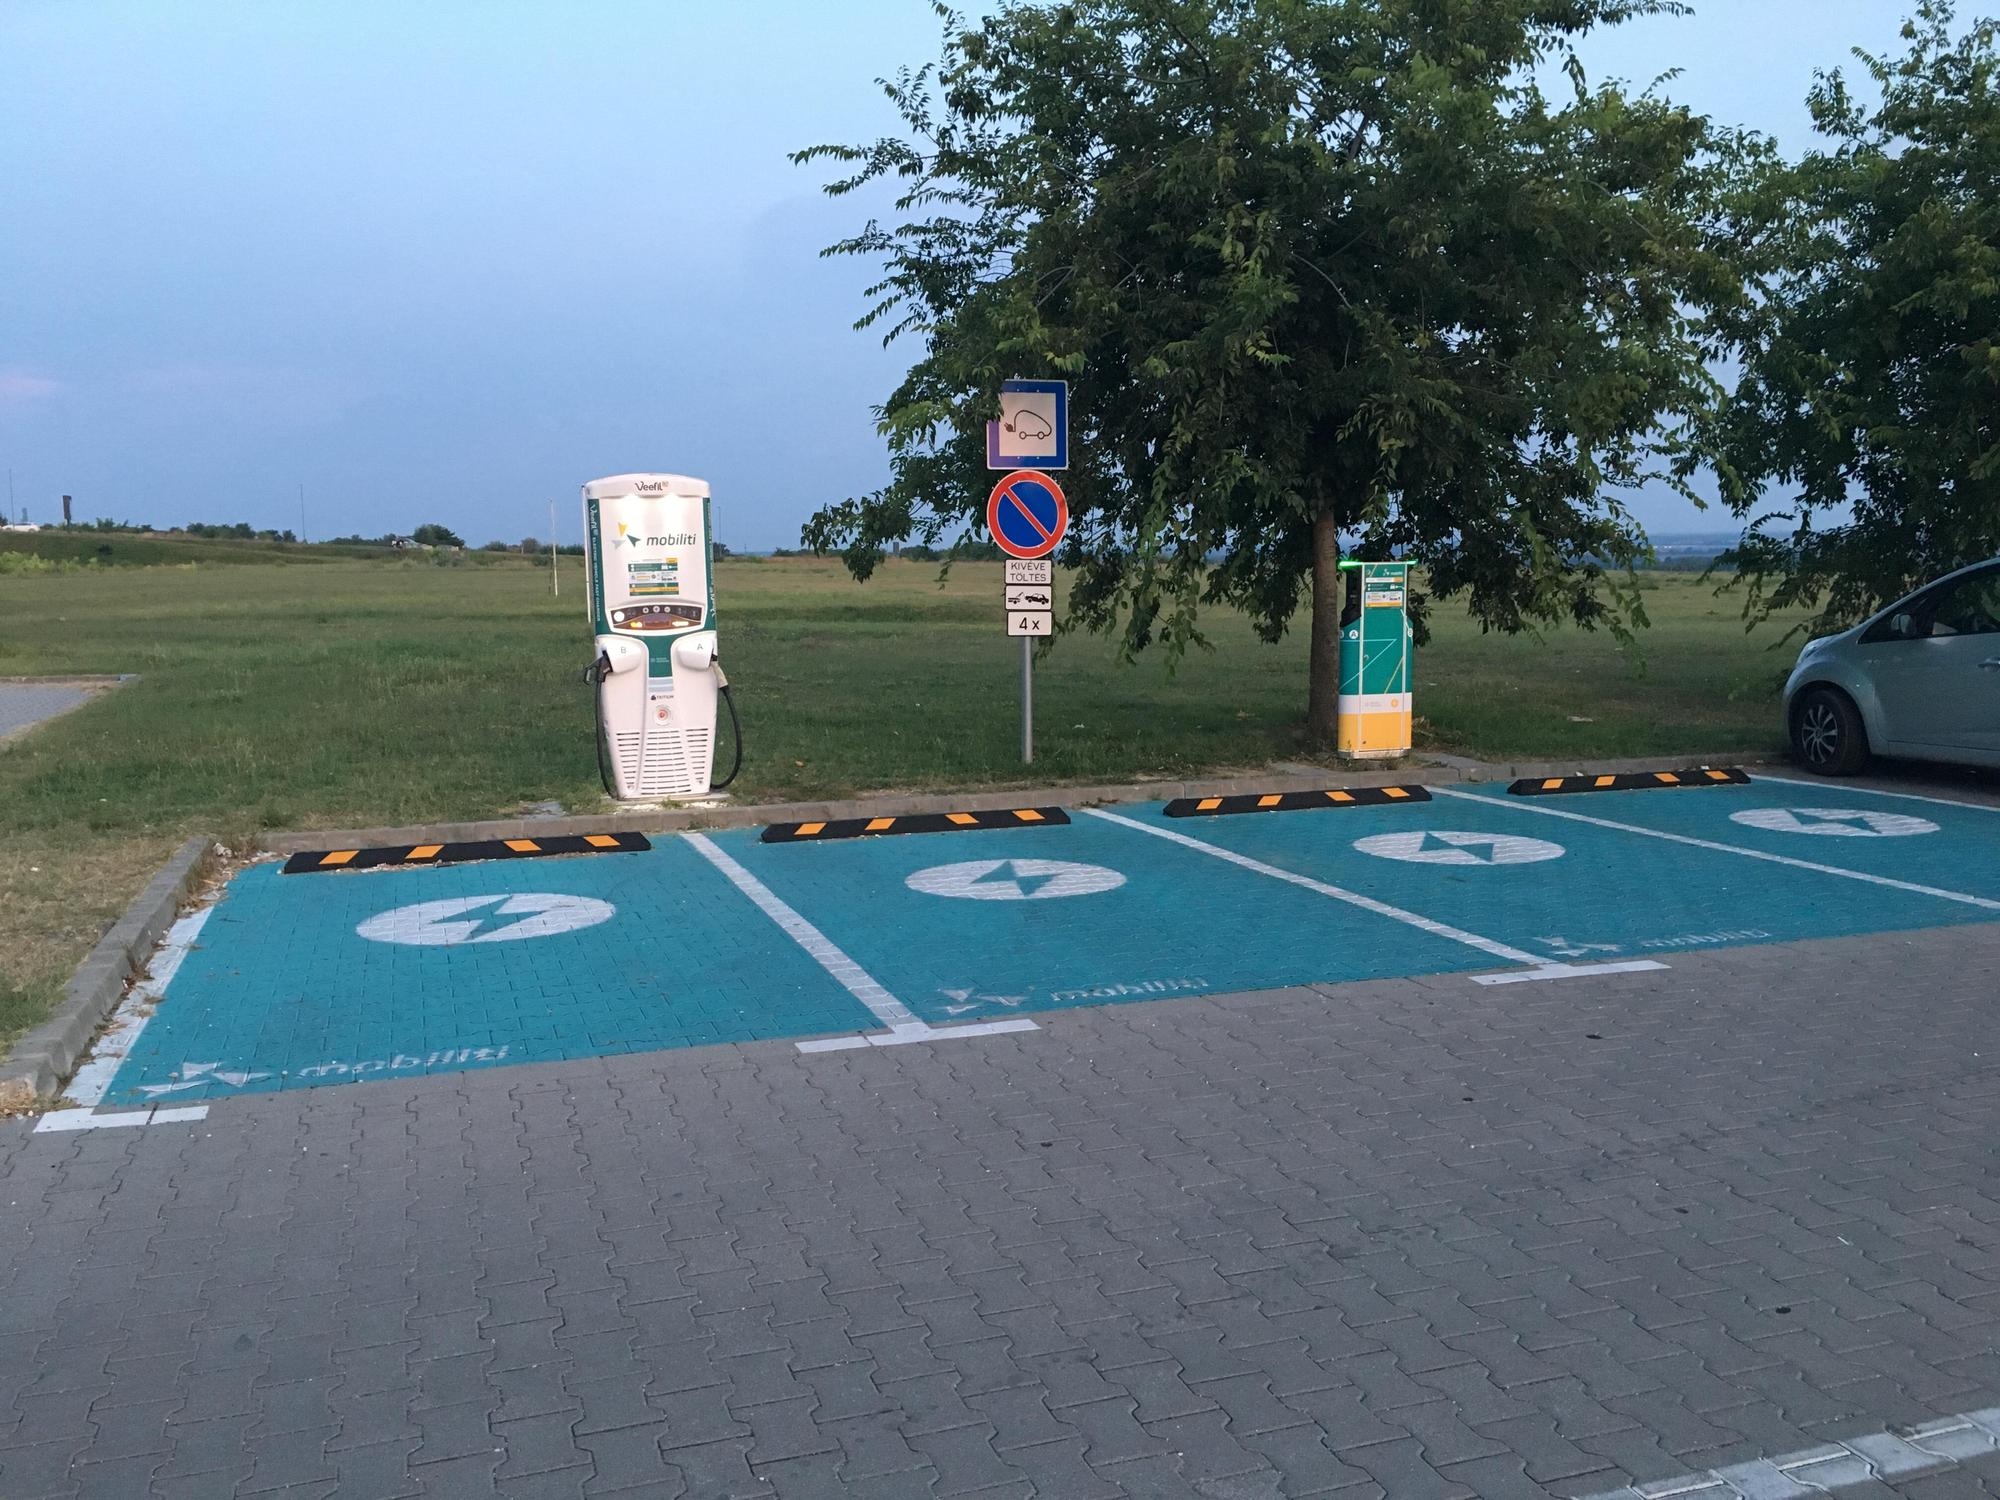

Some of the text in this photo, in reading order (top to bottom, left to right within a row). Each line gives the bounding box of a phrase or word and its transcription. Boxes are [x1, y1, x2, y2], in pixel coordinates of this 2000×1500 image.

[635, 481, 663, 491] Veefil
[646, 533, 696, 546] mobiliti
[1010, 560, 1045, 571] KIVÉVE
[1019, 616, 1028, 631] 4
[620, 646, 626, 654] B
[697, 643, 703, 651] A
